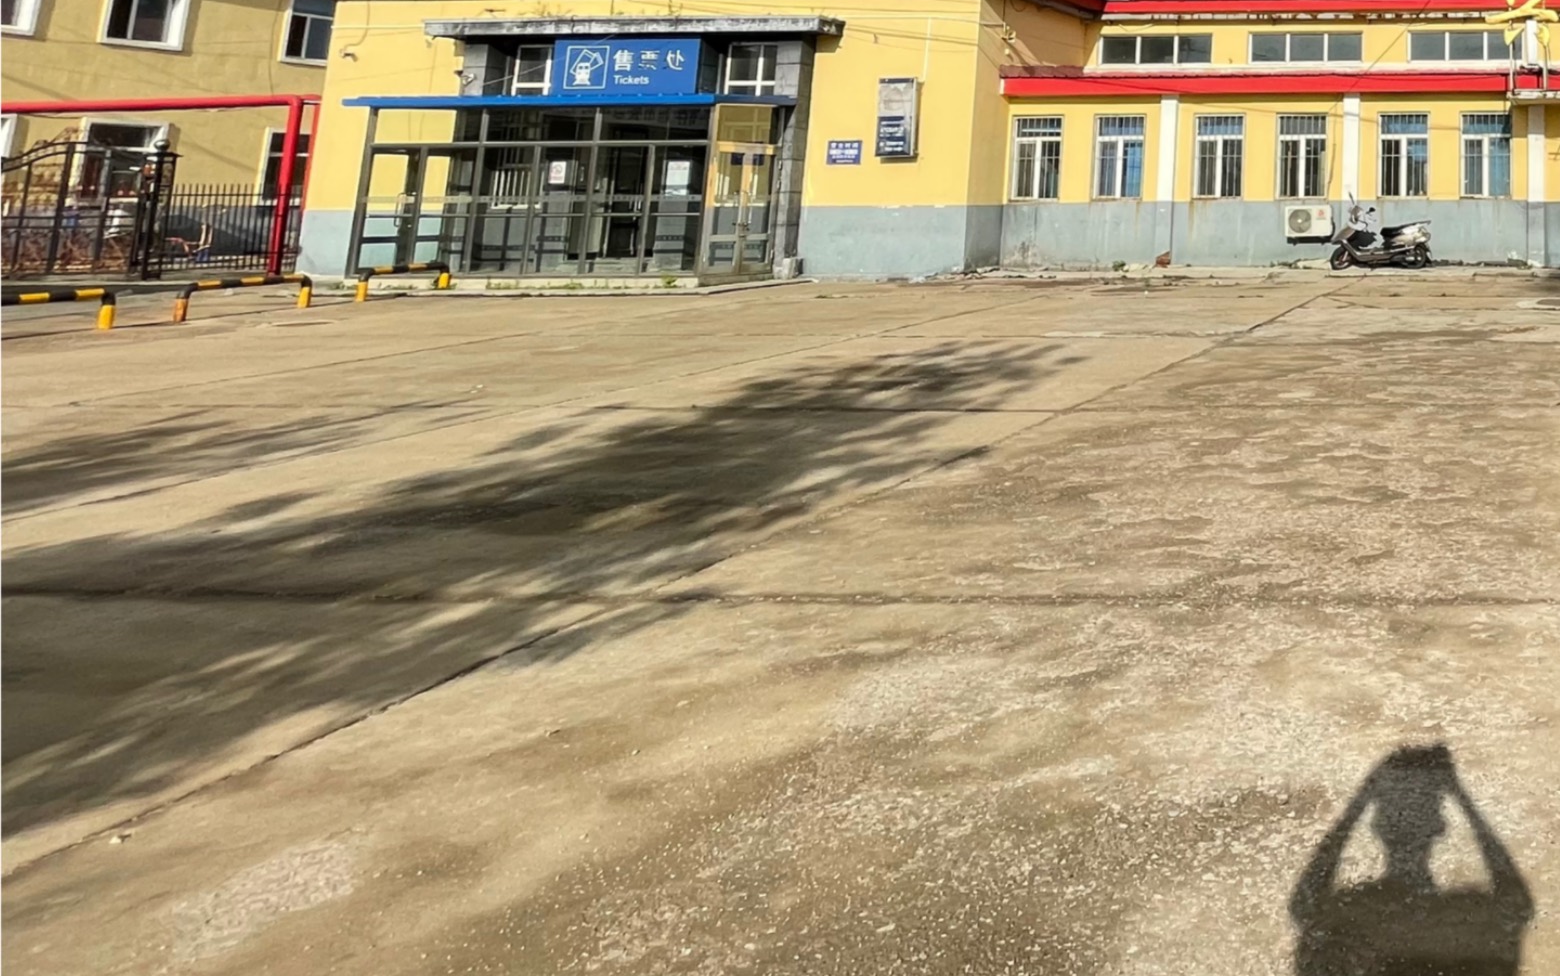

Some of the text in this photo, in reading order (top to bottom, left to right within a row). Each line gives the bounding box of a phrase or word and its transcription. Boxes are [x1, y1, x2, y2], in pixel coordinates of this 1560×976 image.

[613, 49, 685, 72] 售票处
[613, 75, 650, 85] Tickets
